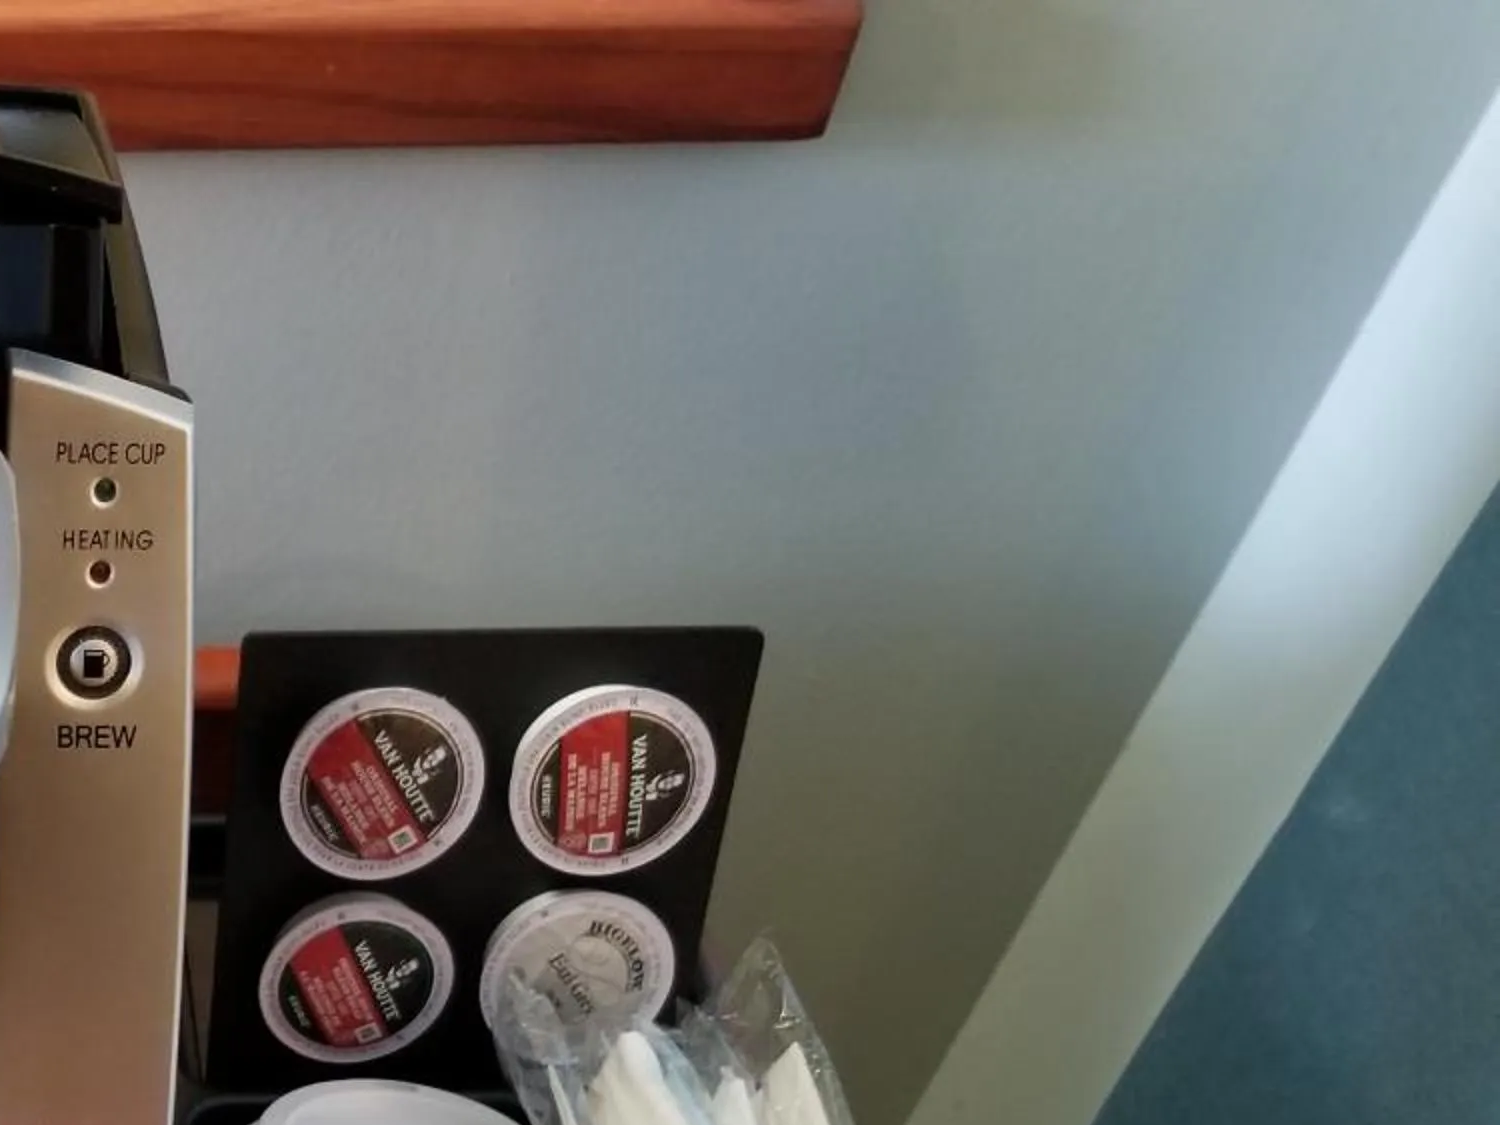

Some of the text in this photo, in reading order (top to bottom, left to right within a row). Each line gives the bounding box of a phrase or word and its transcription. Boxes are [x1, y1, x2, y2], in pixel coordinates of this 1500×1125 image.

[55, 441, 165, 465] PLACE CUP
[62, 529, 154, 551] HEATING
[57, 725, 137, 750] BREW
[374, 729, 435, 823] VAN HOUTTE
[625, 733, 648, 839] VAN HOUTTE
[355, 939, 402, 1021] VAN HOUTTE
[588, 920, 645, 992] BIGELOW
